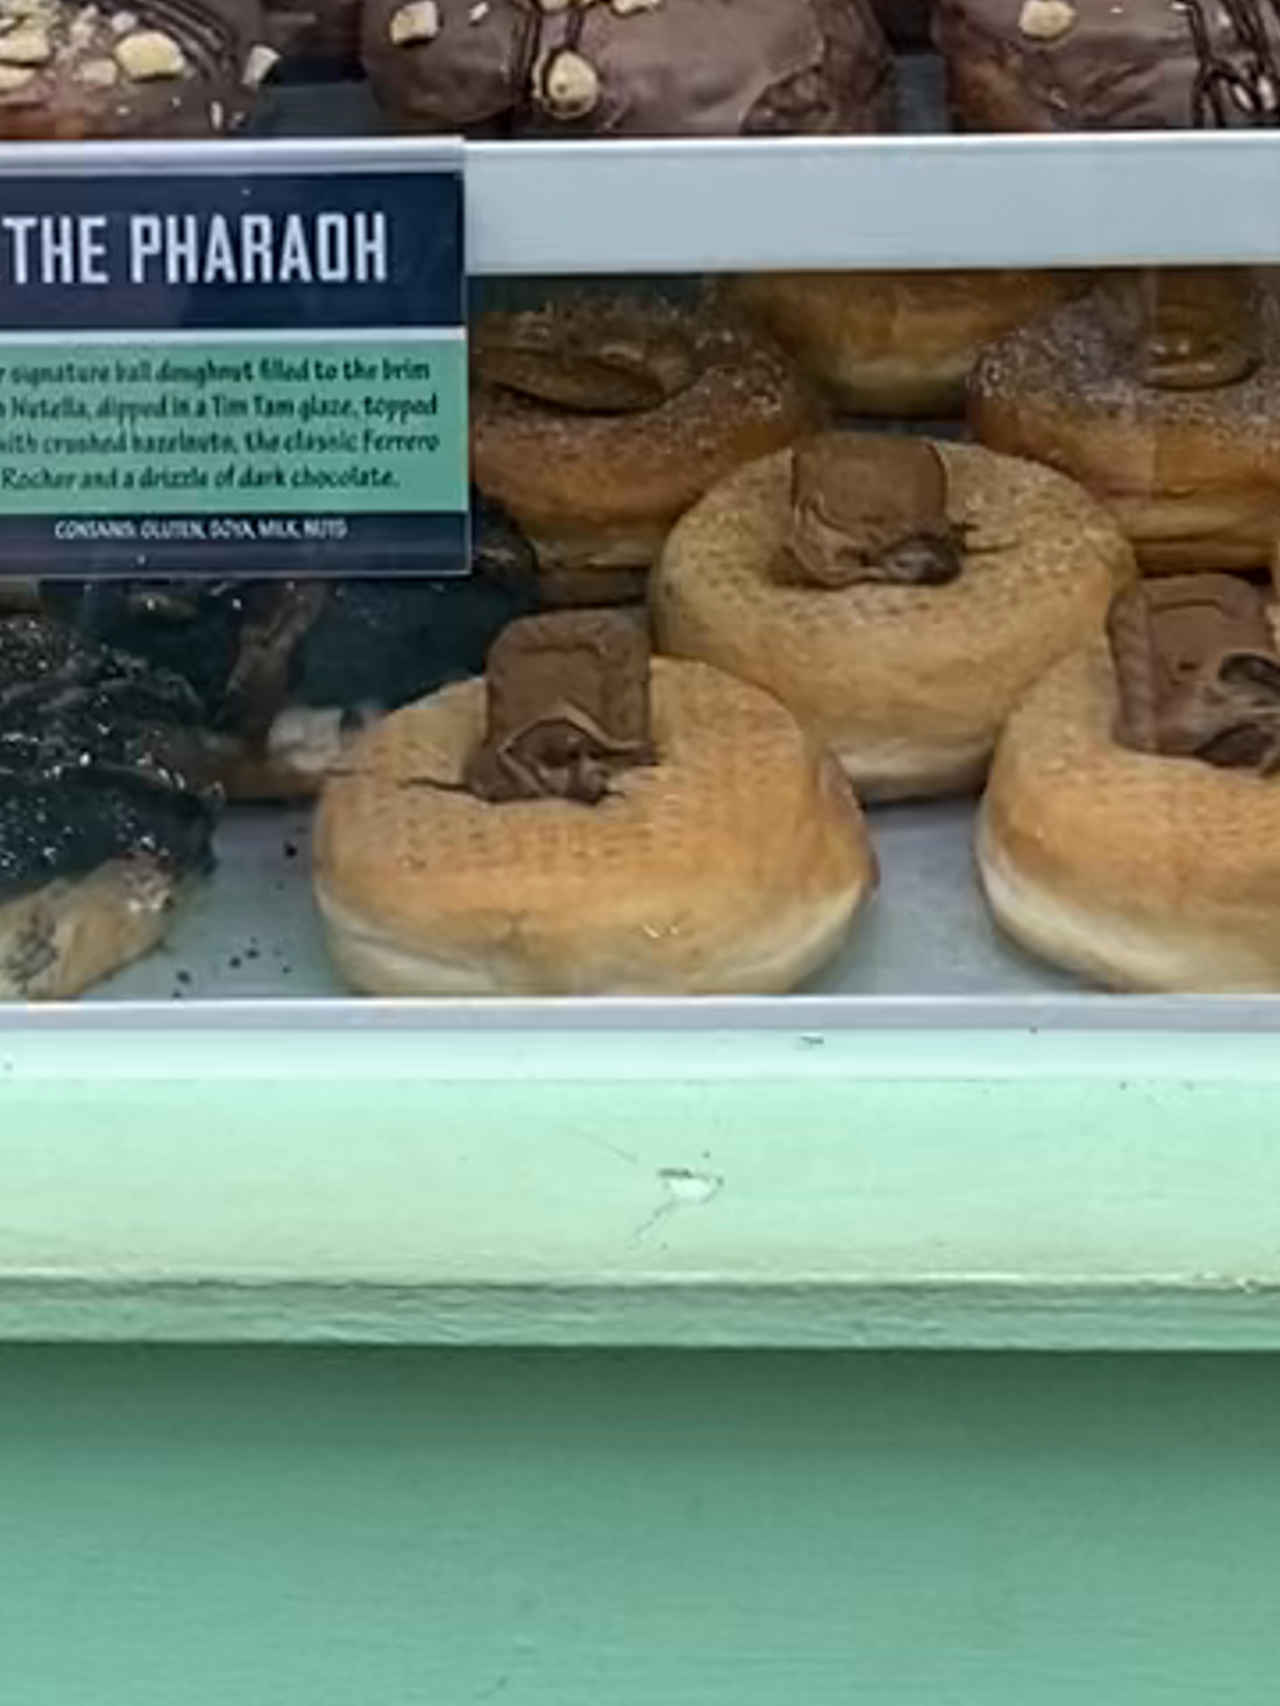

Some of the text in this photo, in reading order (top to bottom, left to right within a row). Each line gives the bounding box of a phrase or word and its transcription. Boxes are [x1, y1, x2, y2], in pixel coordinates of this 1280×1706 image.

[1, 213, 387, 283] THE PHARAOH
[9, 363, 111, 389] signature
[114, 360, 152, 383] ball
[154, 359, 255, 389] doughnut
[258, 357, 310, 382] filled
[313, 360, 339, 383] to
[342, 357, 379, 382] the
[381, 358, 431, 381] brim
[10, 396, 92, 421] Nutella,
[95, 393, 169, 426] dipped
[171, 396, 191, 419] in
[193, 399, 208, 418] a
[210, 394, 249, 418] Tim
[252, 394, 295, 418] Tam
[297, 393, 359, 423] glaze,
[361, 392, 439, 425] topped
[42, 427, 128, 455] crushed
[131, 427, 240, 455] hazelnuts,
[243, 428, 281, 453] the
[282, 429, 358, 453] classic
[362, 423, 441, 454] Ferrero
[1, 463, 400, 490] Rocher and a drizzle of dark chocolate.
